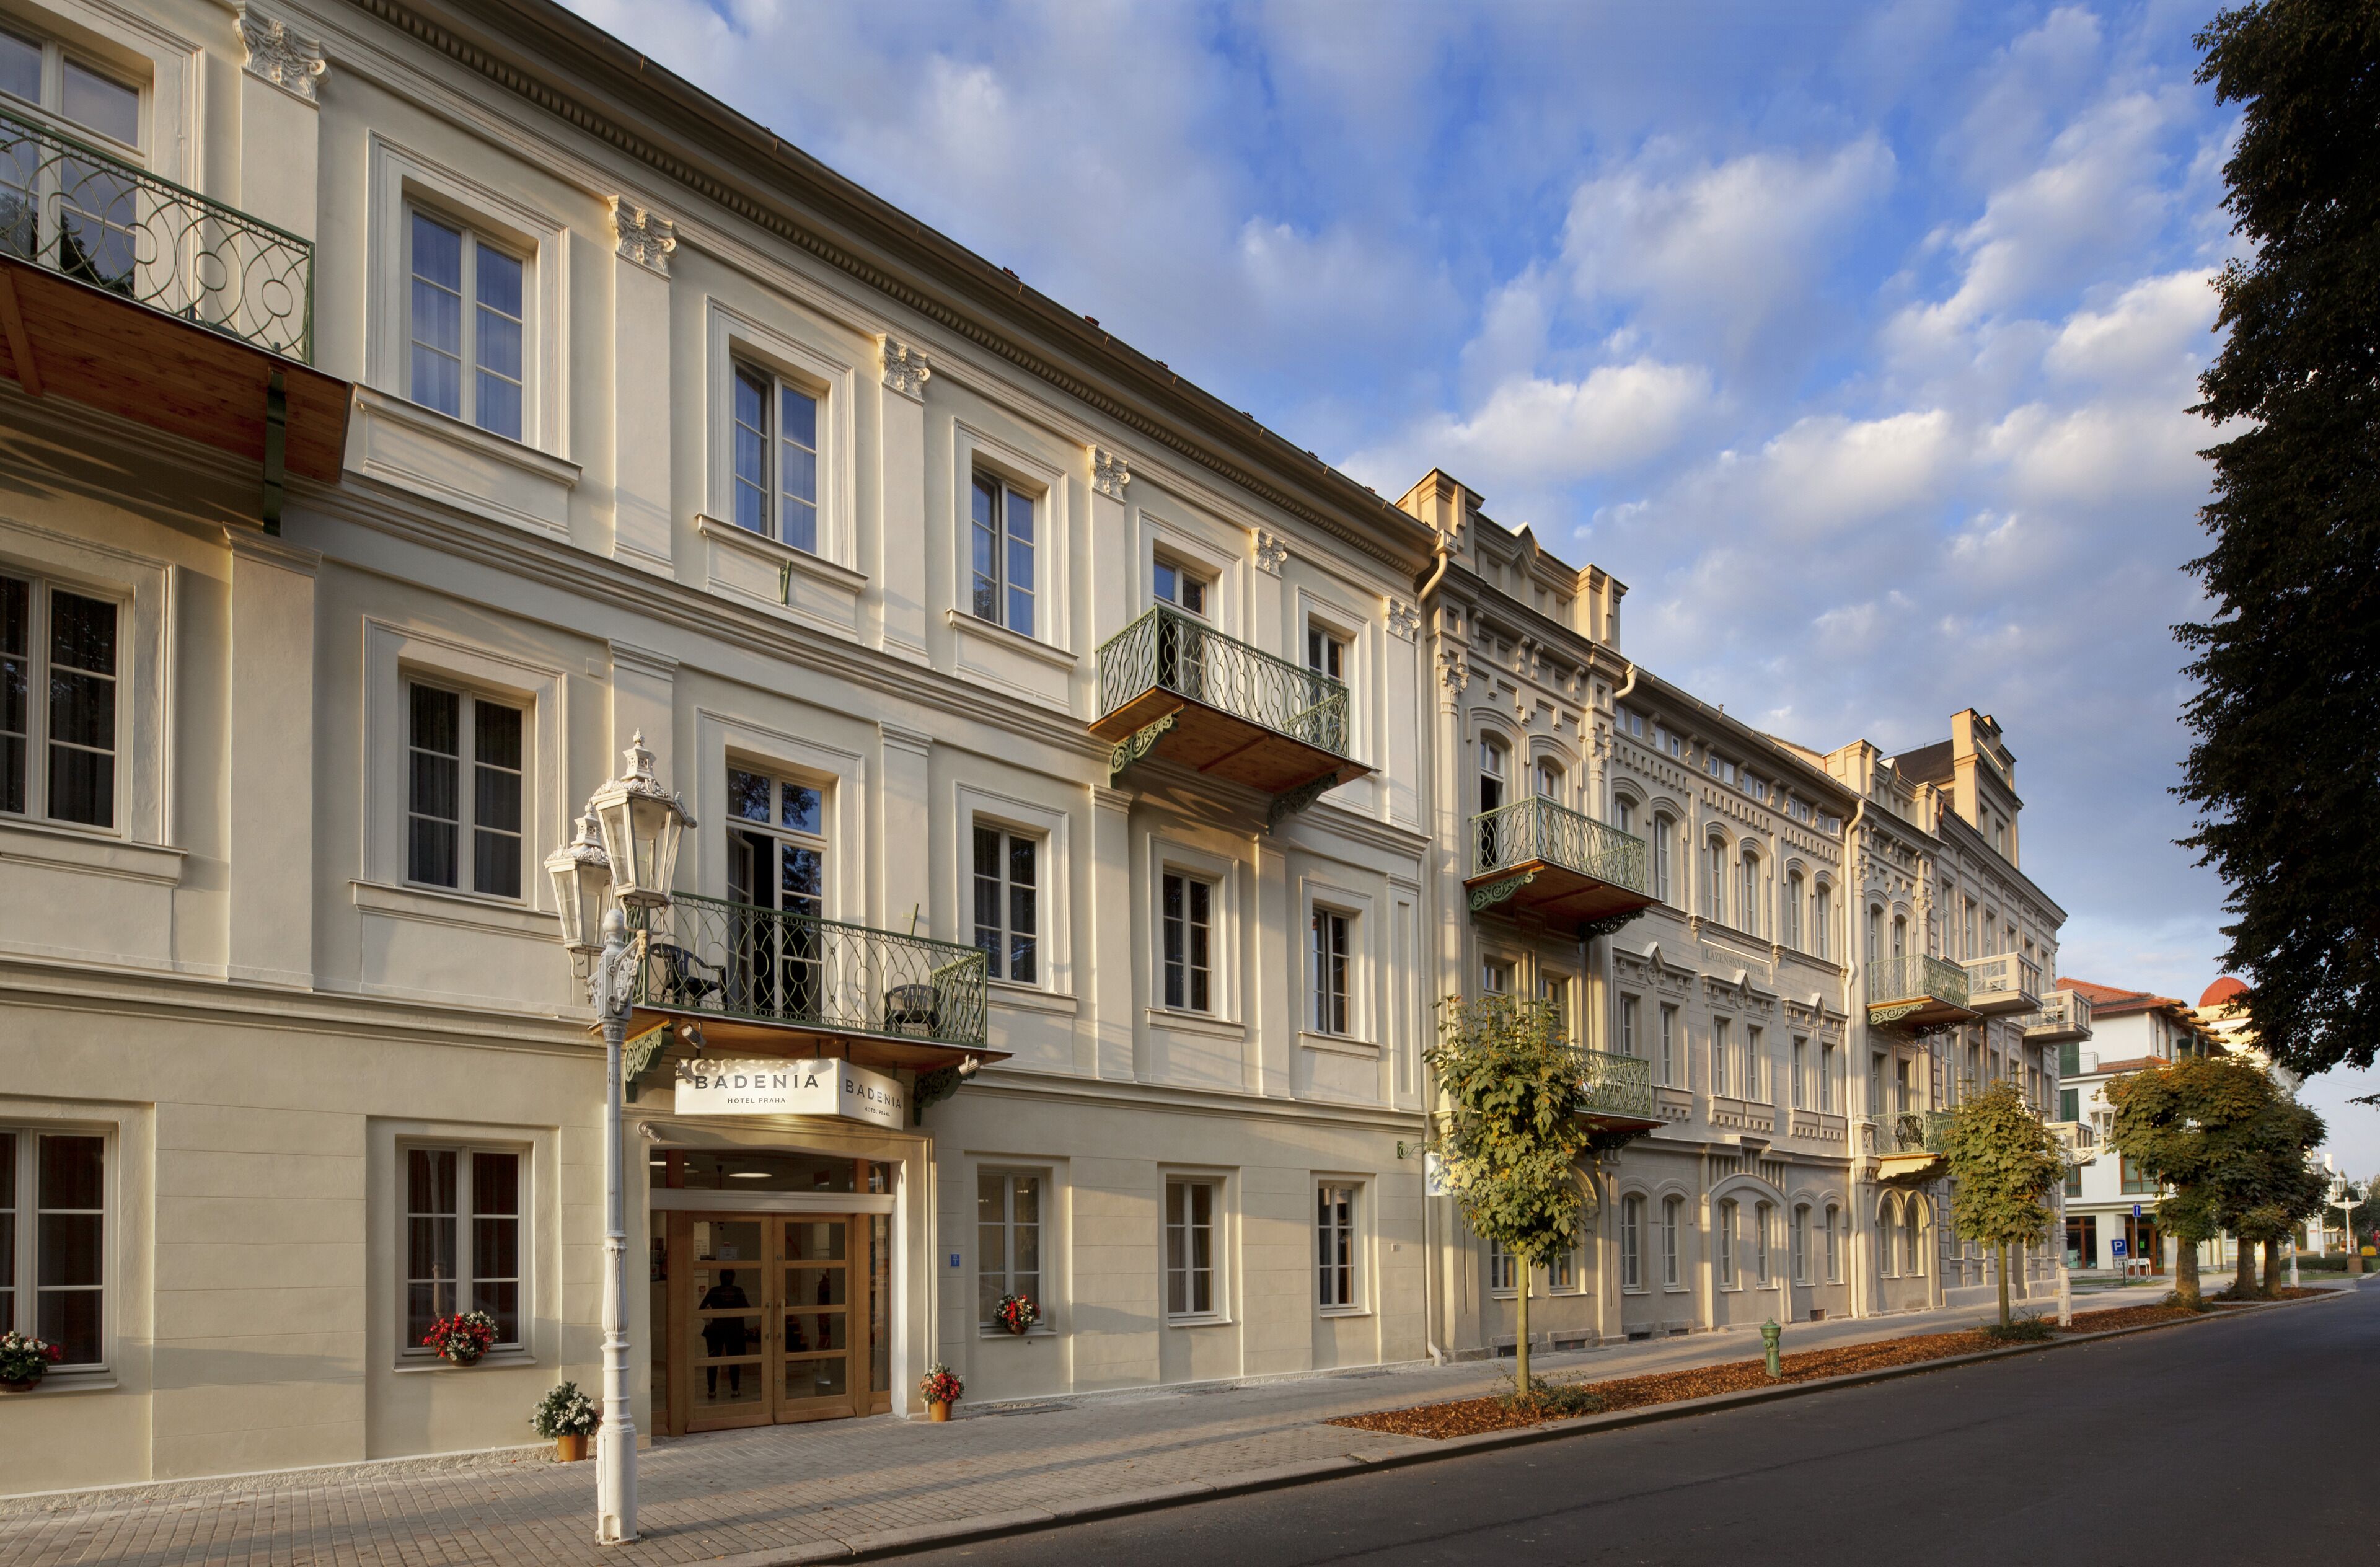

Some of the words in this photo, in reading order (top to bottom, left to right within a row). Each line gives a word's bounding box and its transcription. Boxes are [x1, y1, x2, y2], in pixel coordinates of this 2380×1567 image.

[1706, 948, 1741, 968] LÁZEŇSKÝ
[1743, 961, 1766, 977] HOTEL
[695, 1074, 819, 1090] BADENIA
[845, 1079, 901, 1109] BADENIA
[864, 1106, 878, 1114] HOTEL
[2114, 1241, 2123, 1251] P
